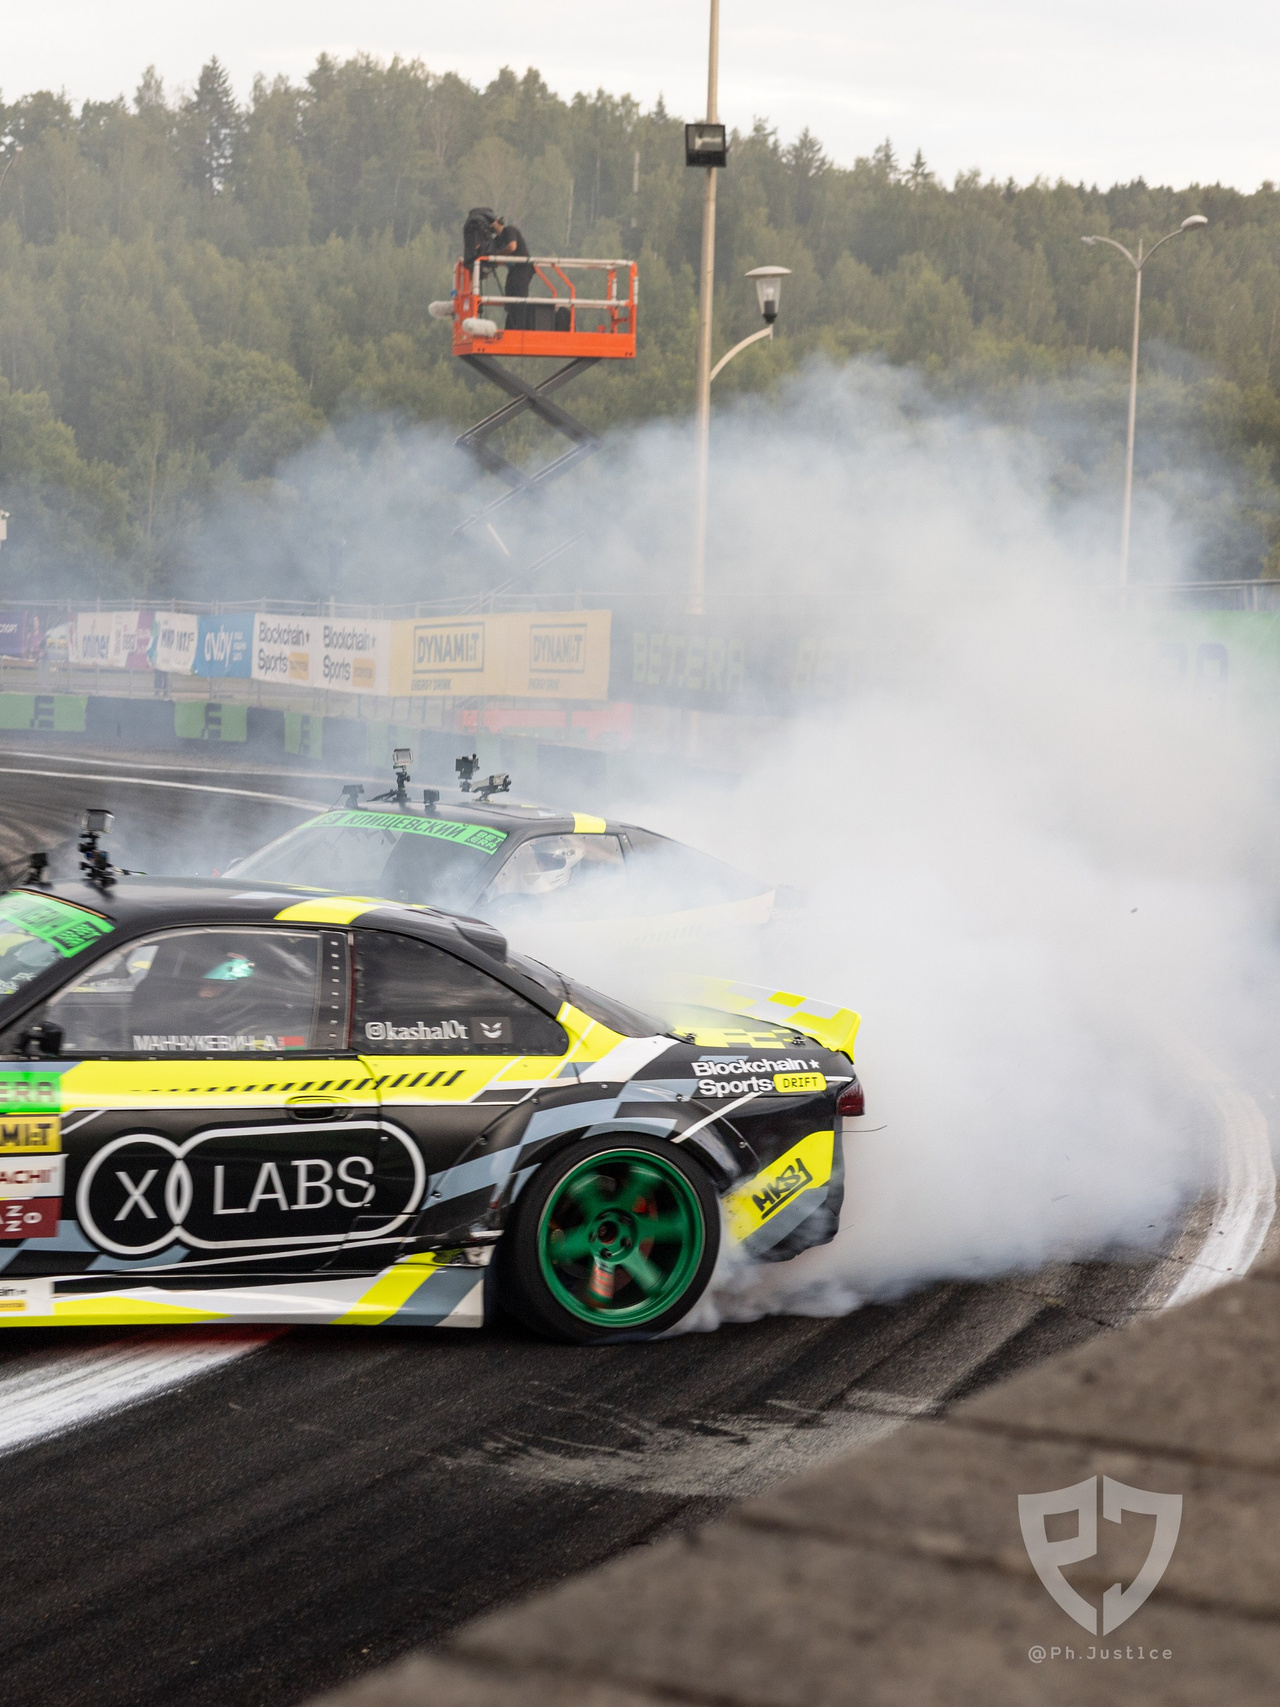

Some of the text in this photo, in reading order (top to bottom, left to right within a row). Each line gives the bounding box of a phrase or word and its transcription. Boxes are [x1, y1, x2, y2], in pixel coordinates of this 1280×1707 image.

[258, 621, 305, 646] Blockchain
[322, 625, 371, 652] Blockchain
[257, 648, 288, 675] Sports
[322, 654, 351, 684] Sports
[346, 813, 470, 839] КЛИЩЕВСКИЙ
[691, 1058, 808, 1077] Blockchain
[698, 1076, 773, 1097] Sports
[782, 1076, 818, 1089] DRIFT
[114, 1156, 376, 1222] X LABS
